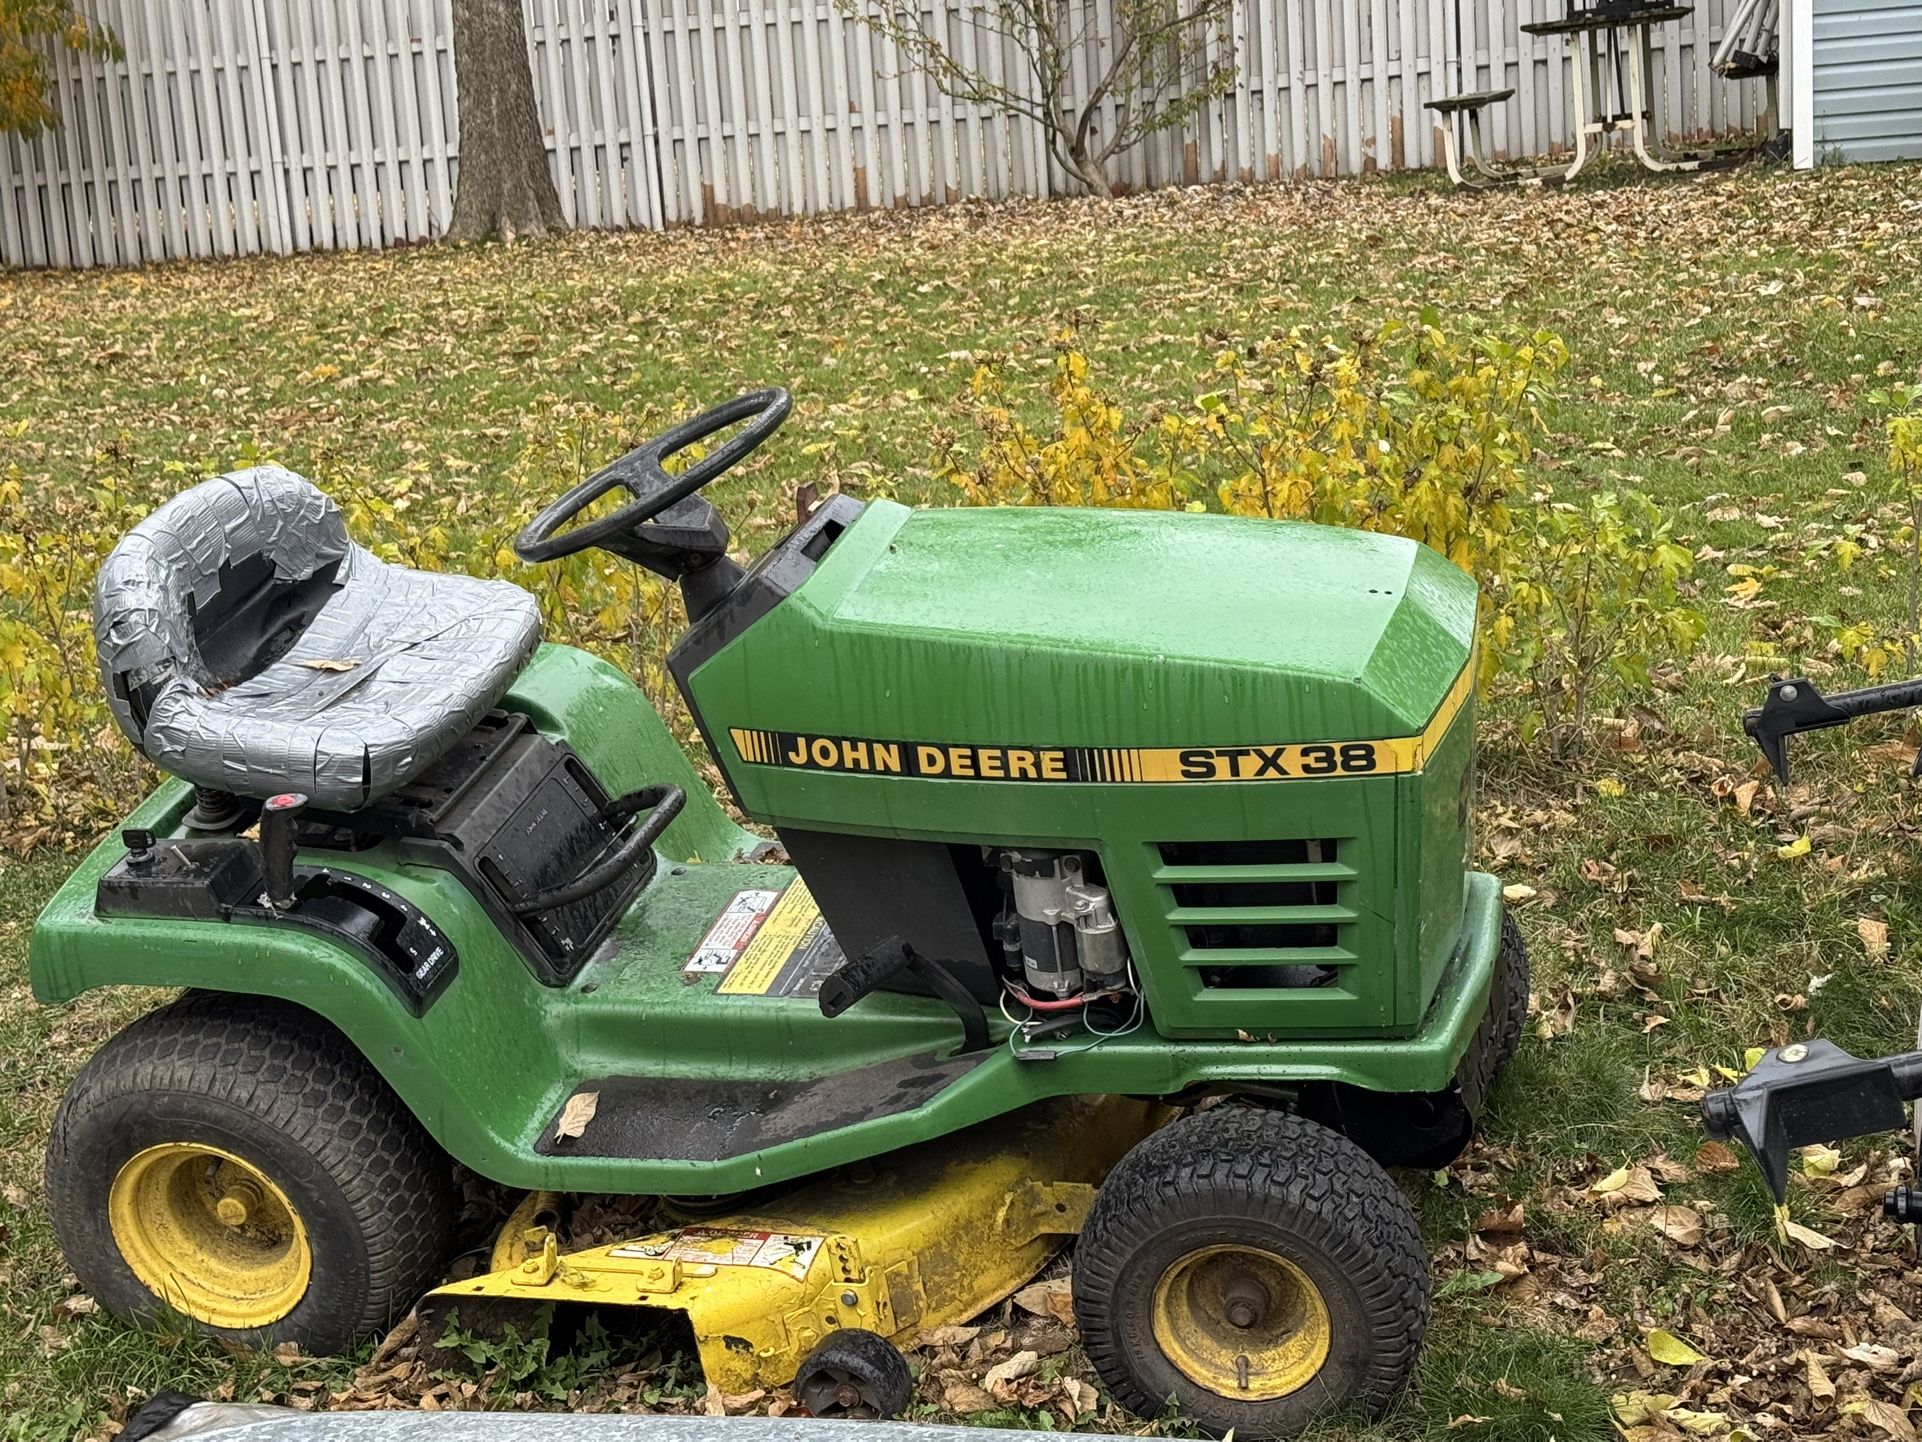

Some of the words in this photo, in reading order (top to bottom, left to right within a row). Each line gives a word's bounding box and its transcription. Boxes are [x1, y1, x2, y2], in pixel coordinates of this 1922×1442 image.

[788, 736, 902, 773] JOHN
[917, 746, 1068, 779] DEERE
[1179, 747, 1291, 779] STX
[1300, 743, 1377, 775] 38
[381, 891, 391, 899] 3
[415, 961, 432, 980] GEAR
[427, 946, 444, 966] DRIVE
